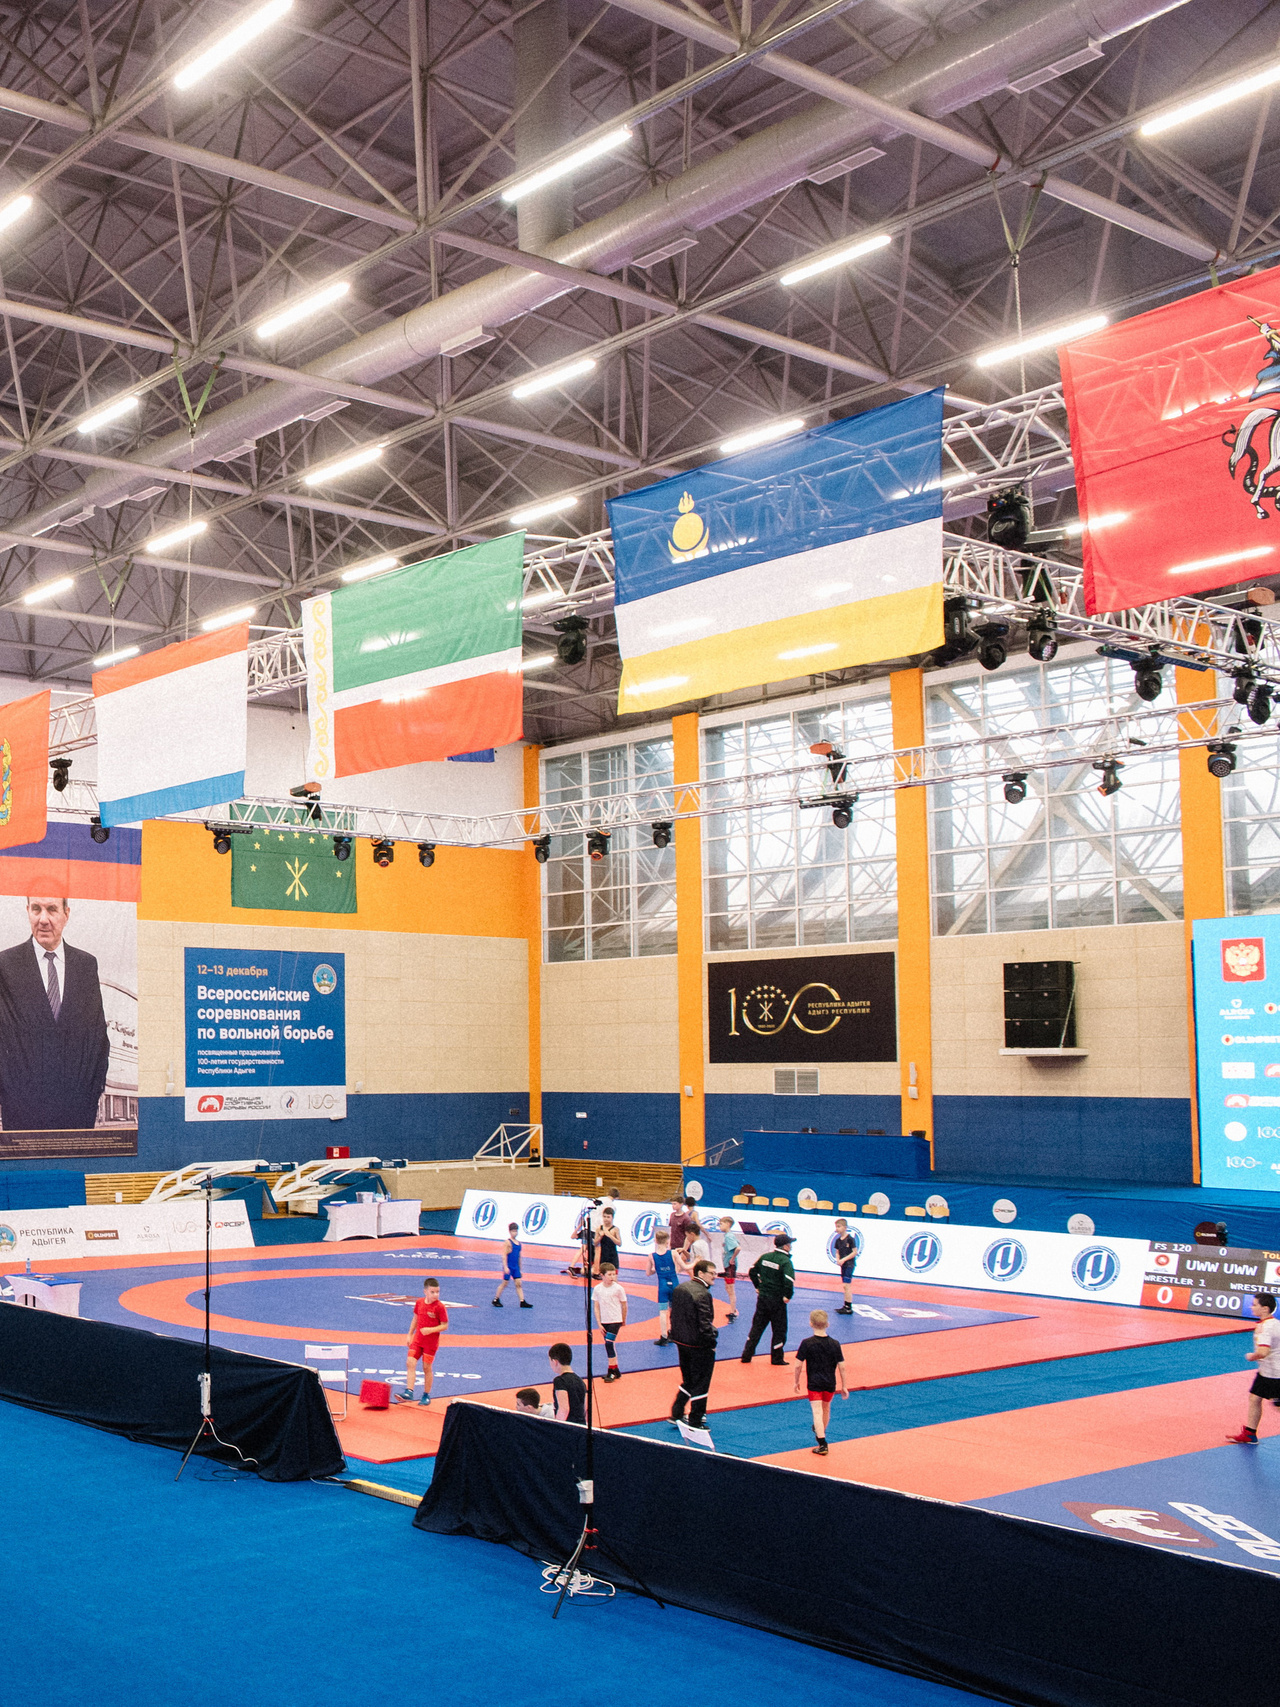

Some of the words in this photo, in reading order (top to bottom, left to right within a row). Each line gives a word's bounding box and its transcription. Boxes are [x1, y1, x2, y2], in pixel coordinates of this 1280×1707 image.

[226, 966, 268, 978] декабря
[197, 985, 310, 1004] Всероссийские
[197, 1008, 301, 1023] соревнования
[197, 1027, 216, 1039] по
[220, 1025, 280, 1040] вольной
[283, 1025, 334, 1043] борьбе
[197, 1067, 233, 1076] Республики
[234, 1067, 256, 1075] Адыгея
[20, 1227, 74, 1237] РЕСПУБЛИКА
[31, 1237, 67, 1246] АДЫГЕЯ
[1154, 1243, 1167, 1251] FS
[1172, 1244, 1192, 1252] 120
[1219, 1248, 1227, 1257] 0
[1186, 1260, 1219, 1273] UWW
[1223, 1263, 1258, 1276] UWW
[1144, 1275, 1194, 1286] WRESTLER
[1199, 1279, 1206, 1287] 1
[1157, 1286, 1173, 1304] 0
[1191, 1293, 1241, 1310] 6:00
